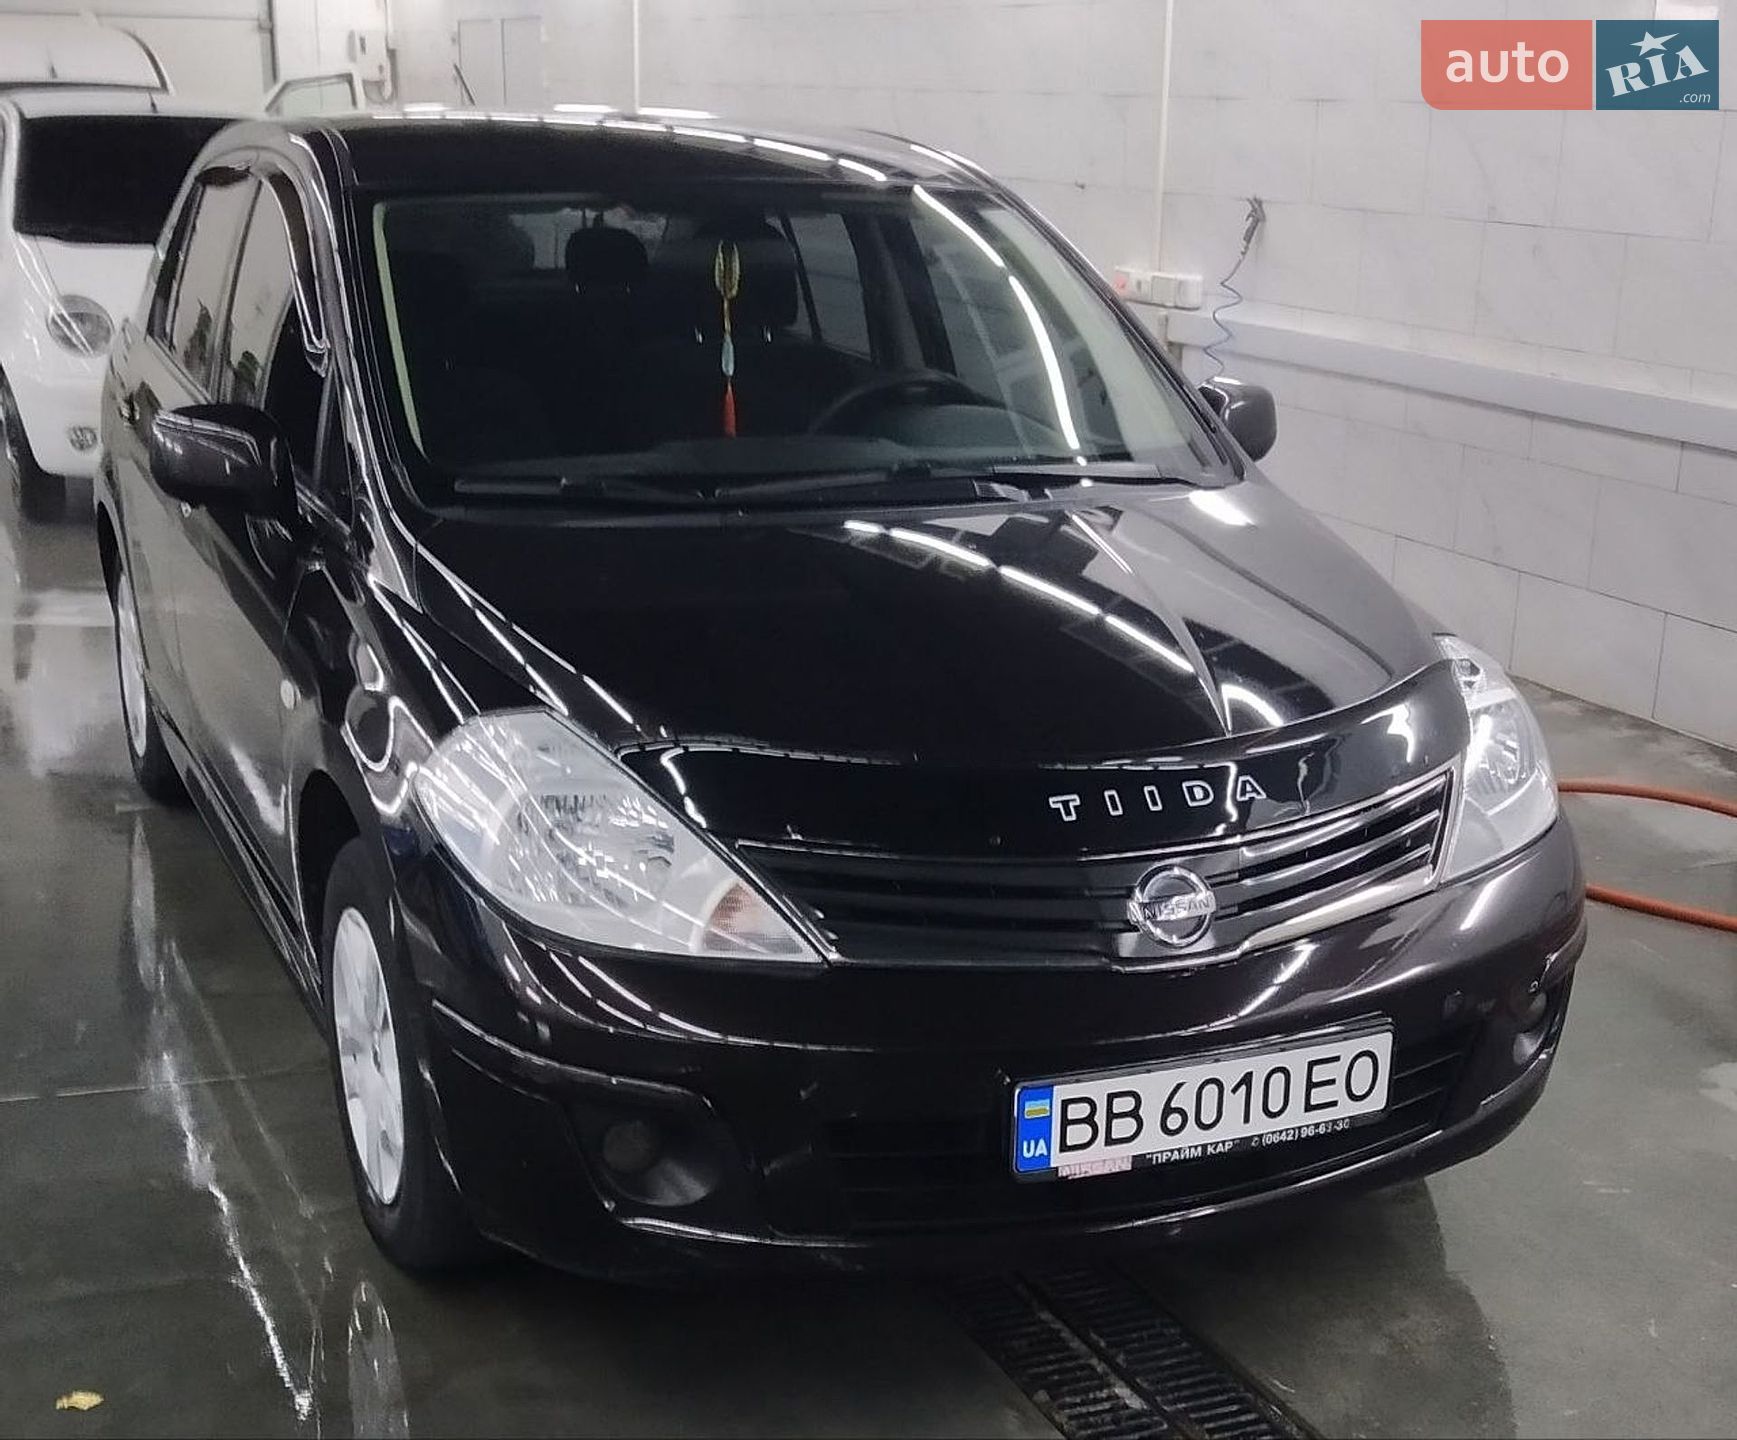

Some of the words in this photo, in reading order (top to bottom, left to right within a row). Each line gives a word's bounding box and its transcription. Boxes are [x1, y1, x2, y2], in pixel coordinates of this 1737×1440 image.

[1049, 775, 1267, 822] TIIDA
[1142, 895, 1211, 920] NISSAN
[1058, 1090, 1144, 1153] BB
[1159, 1066, 1290, 1137] 6010
[1303, 1049, 1380, 1113] EO
[1022, 1138, 1048, 1158] UA
[1261, 1128, 1299, 1147] (0642)
